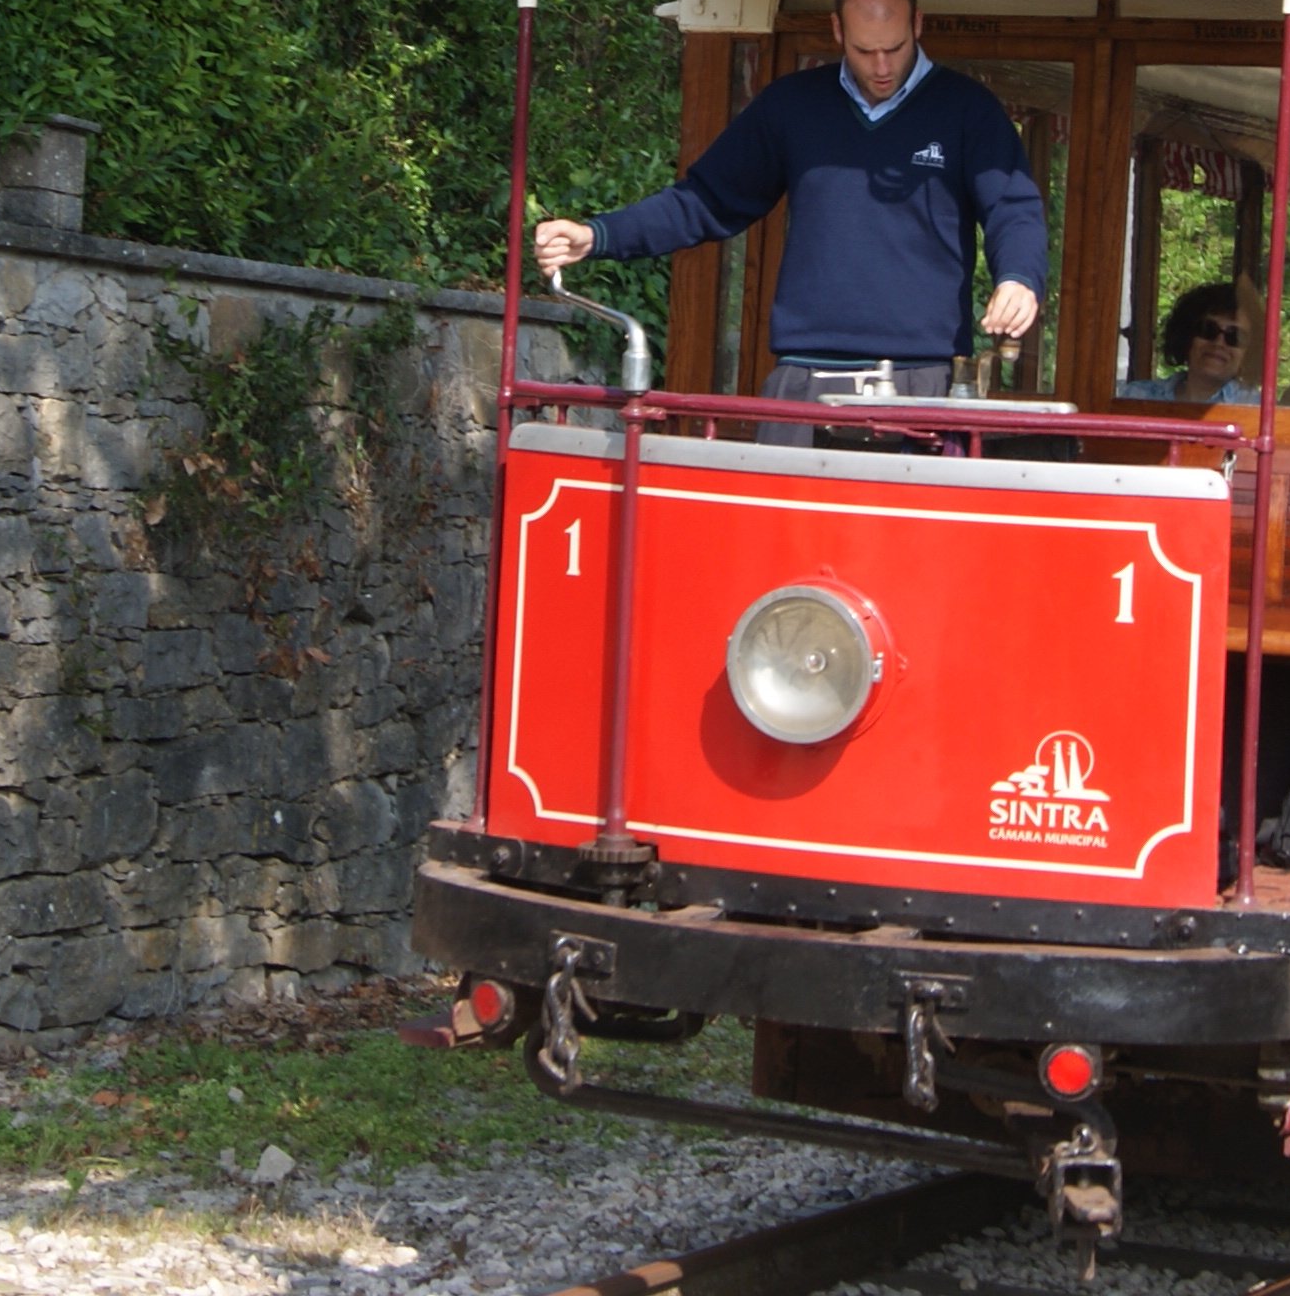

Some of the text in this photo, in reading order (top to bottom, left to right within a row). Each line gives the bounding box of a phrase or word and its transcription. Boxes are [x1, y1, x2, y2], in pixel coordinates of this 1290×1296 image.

[564, 518, 582, 577] 1
[1111, 562, 1135, 624] 1
[989, 798, 1109, 831] SINTRA
[989, 827, 1108, 848] CÂMARA MUNICIPAL
